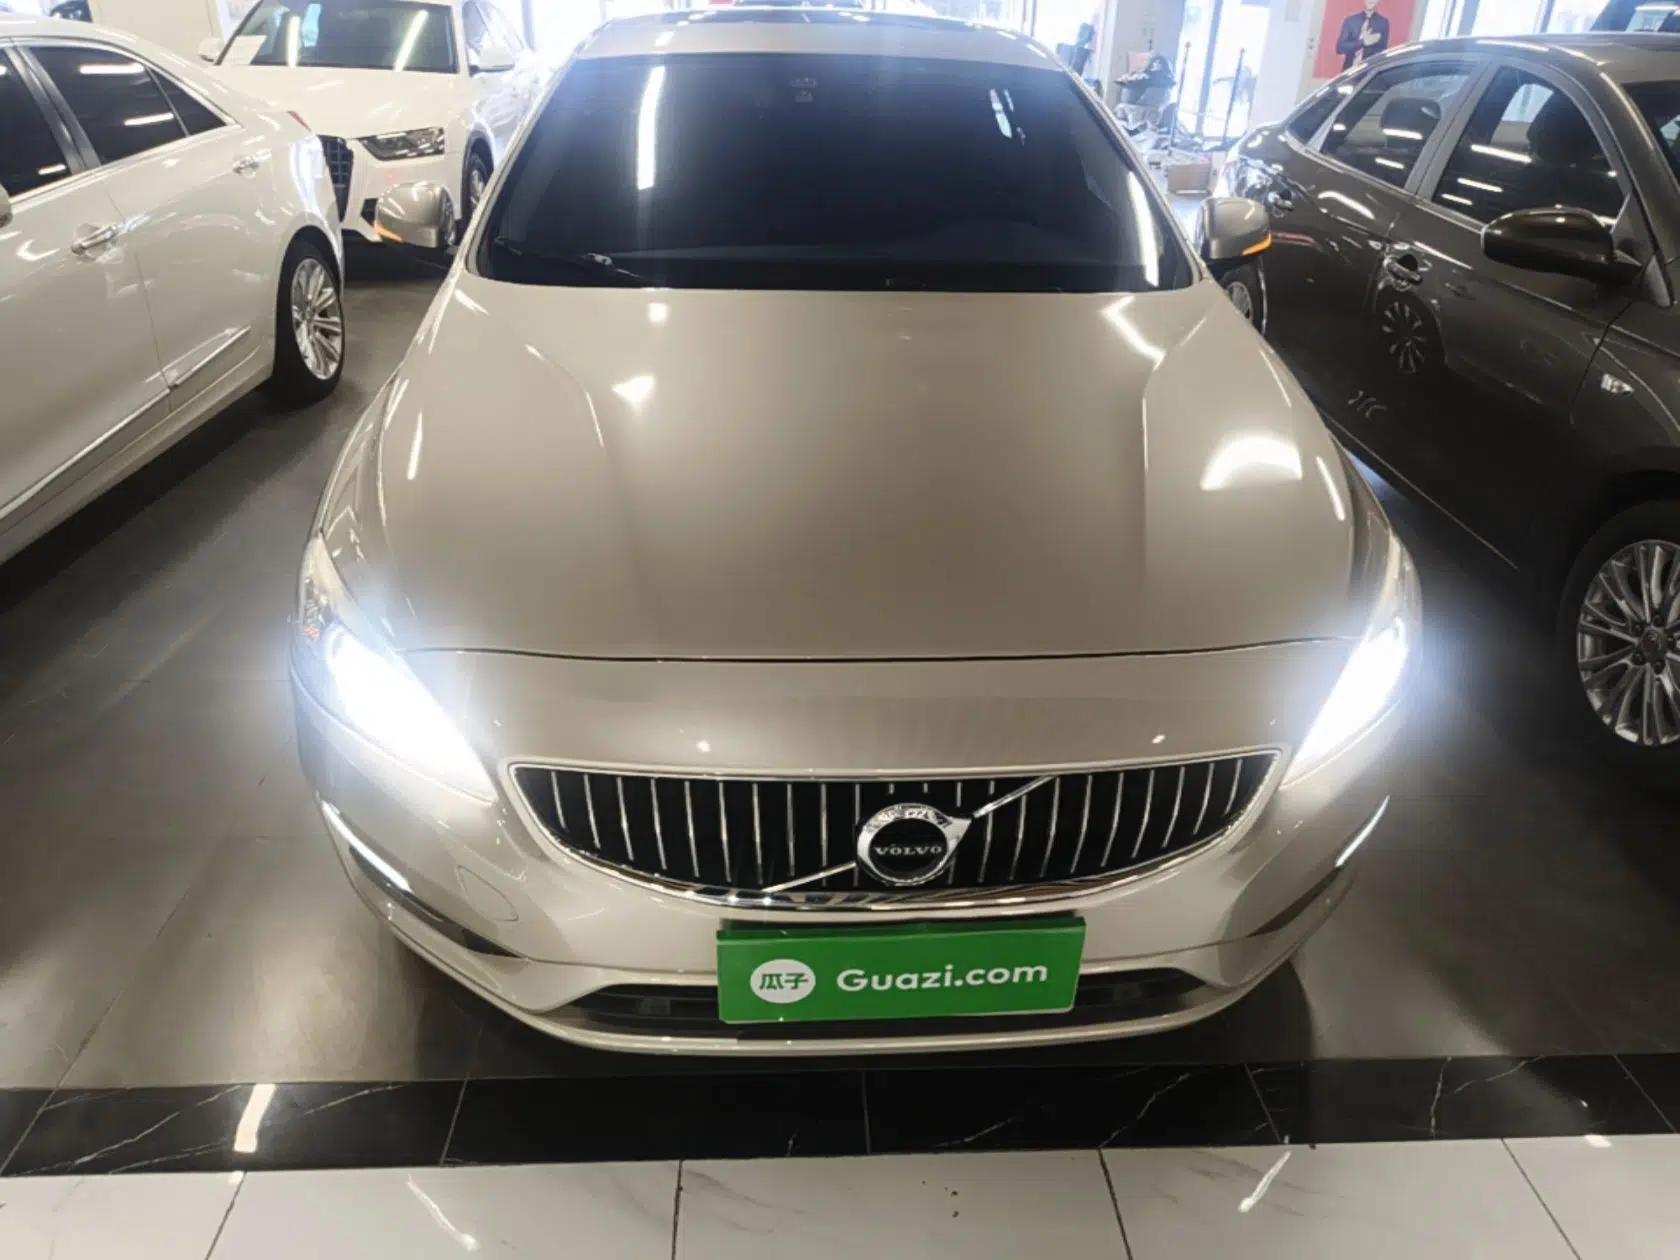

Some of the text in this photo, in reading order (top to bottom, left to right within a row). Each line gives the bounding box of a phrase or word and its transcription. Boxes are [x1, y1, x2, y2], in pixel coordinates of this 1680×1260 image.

[873, 844, 943, 857] VOLVO
[758, 971, 809, 991] 瓜子
[837, 963, 1048, 992] Guazi.com
